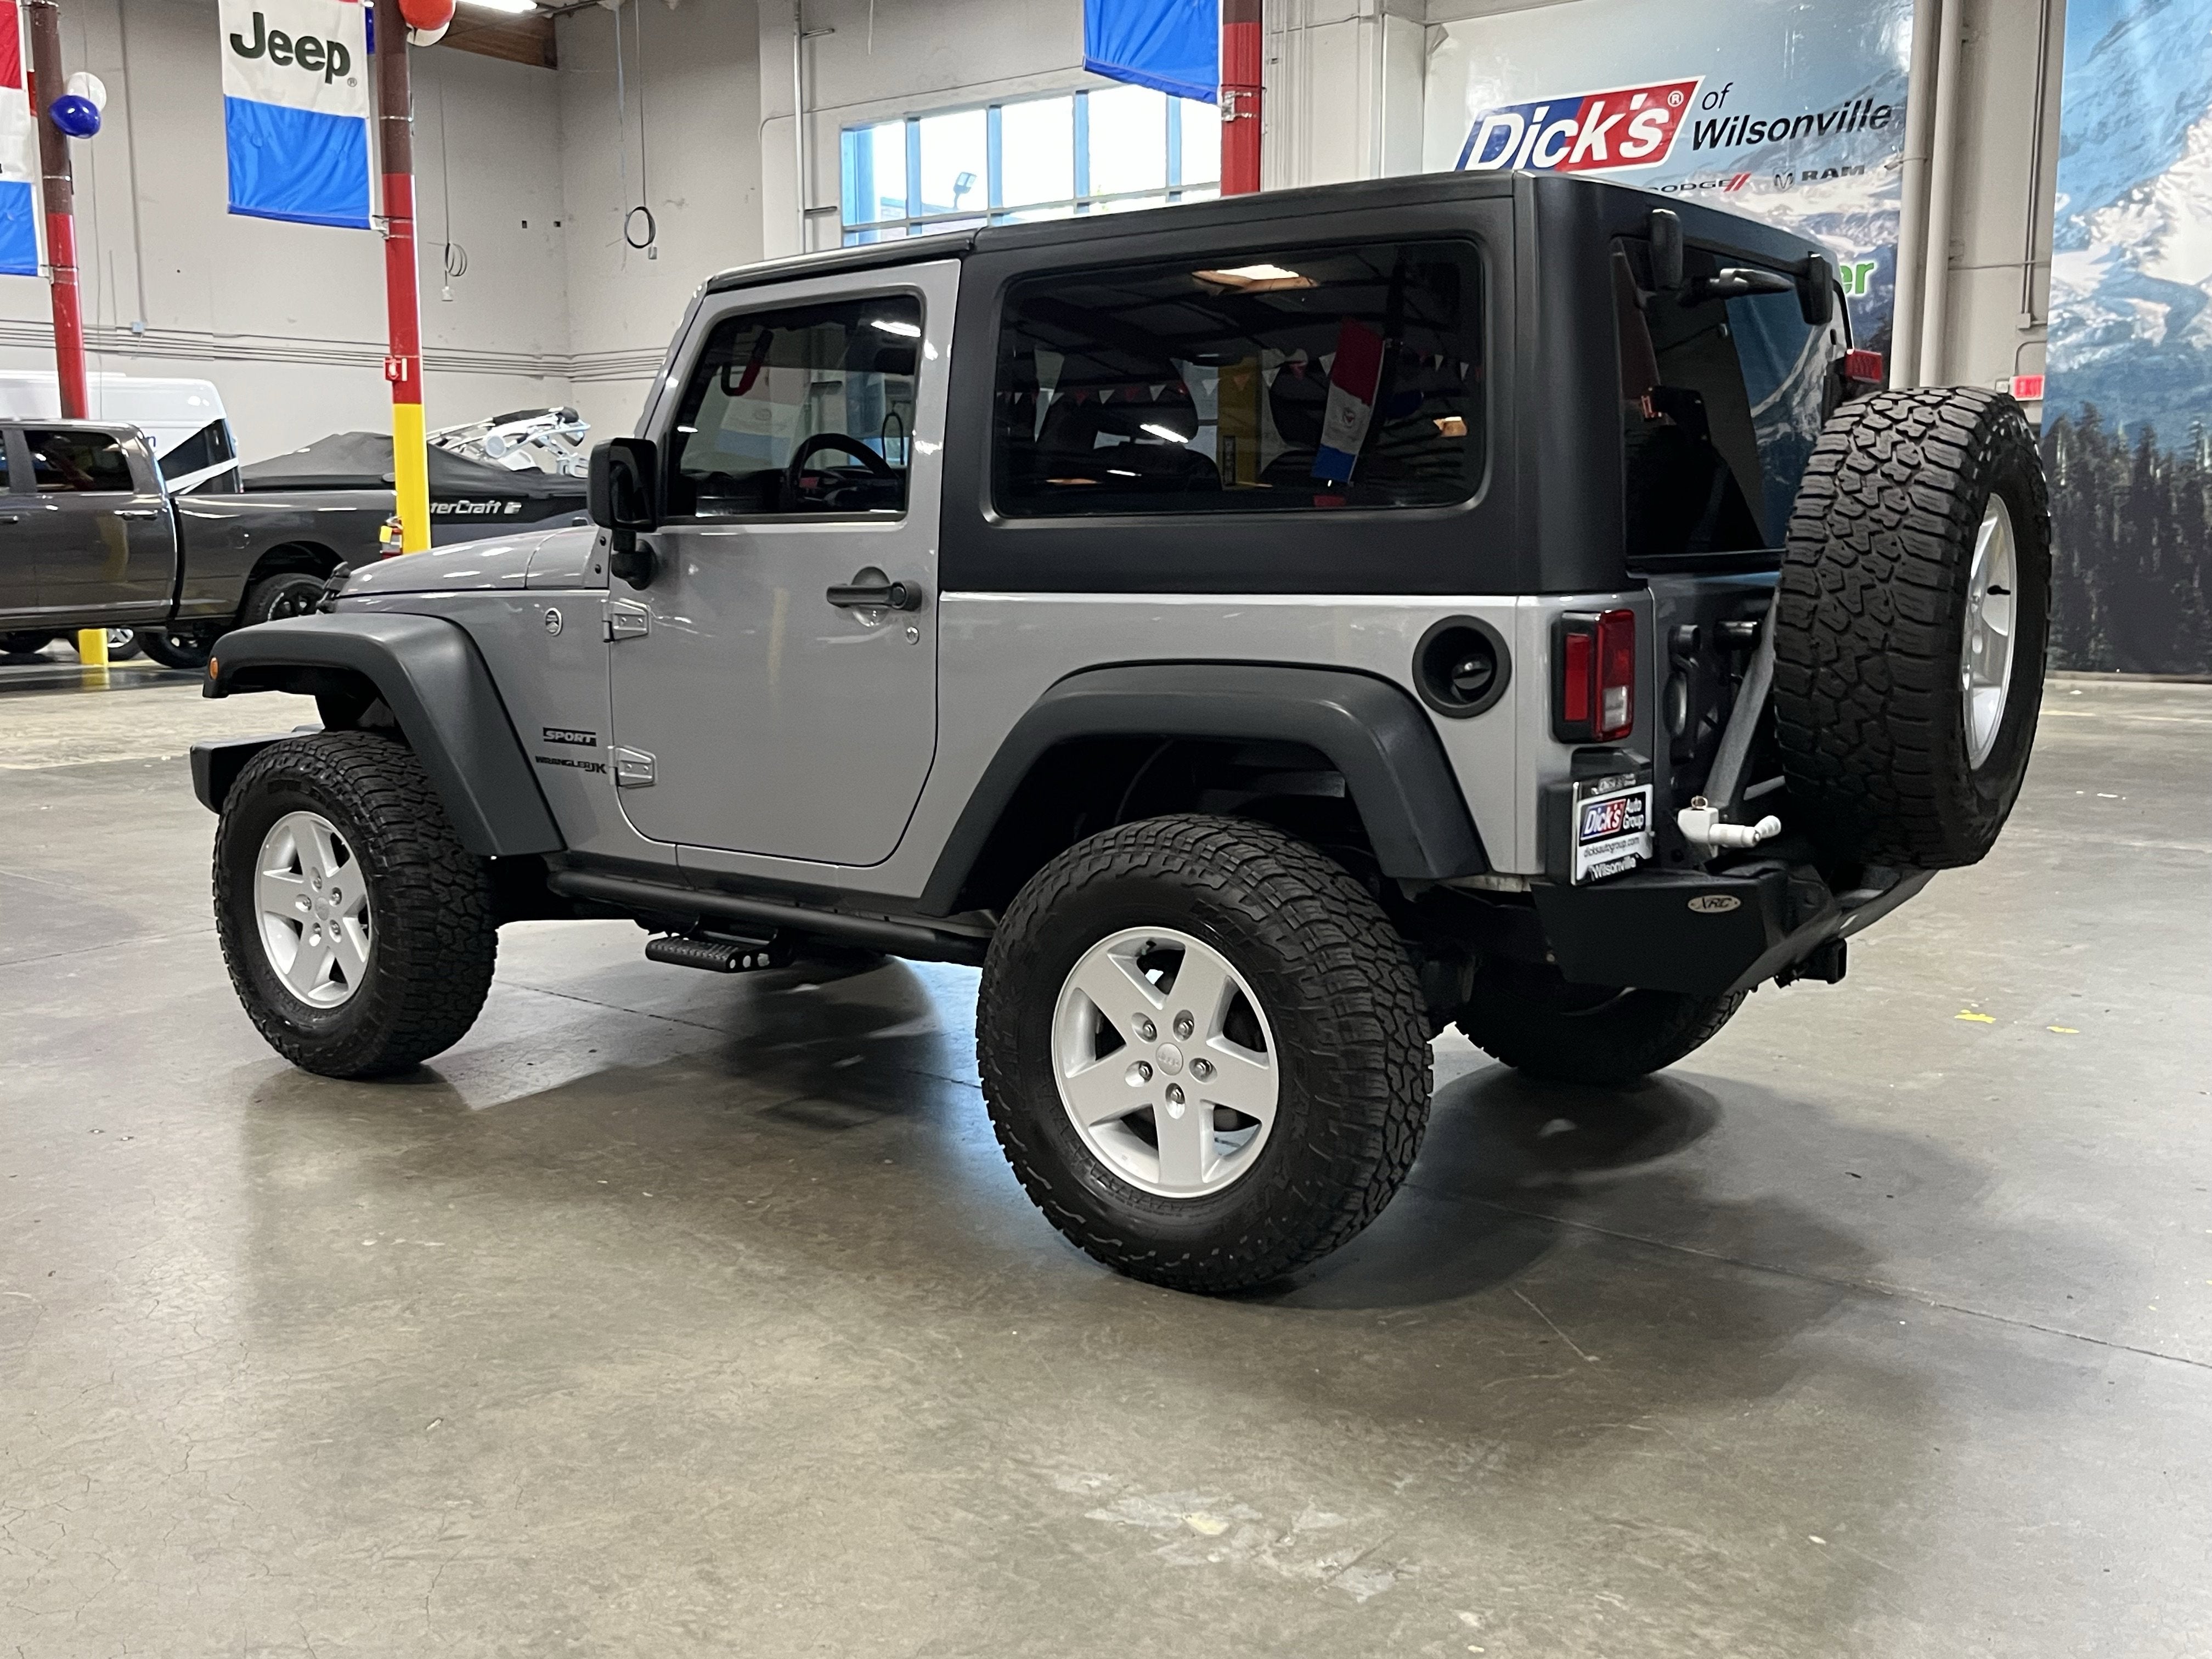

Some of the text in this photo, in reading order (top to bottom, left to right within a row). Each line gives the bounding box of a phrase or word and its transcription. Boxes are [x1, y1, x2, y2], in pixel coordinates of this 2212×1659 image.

[230, 12, 351, 84] Jeep
[1702, 82, 1734, 110] of
[1464, 93, 1670, 171] Dick's
[1692, 98, 1893, 151] Wilsonville
[1801, 165, 1865, 182] RAM
[1647, 179, 1733, 193] ODGE
[544, 730, 596, 744] SPORT
[1625, 798, 1643, 814] Auto
[1584, 804, 1622, 835] Dick's
[1623, 814, 1644, 830] Group
[1592, 856, 1637, 879] Wilsonville
